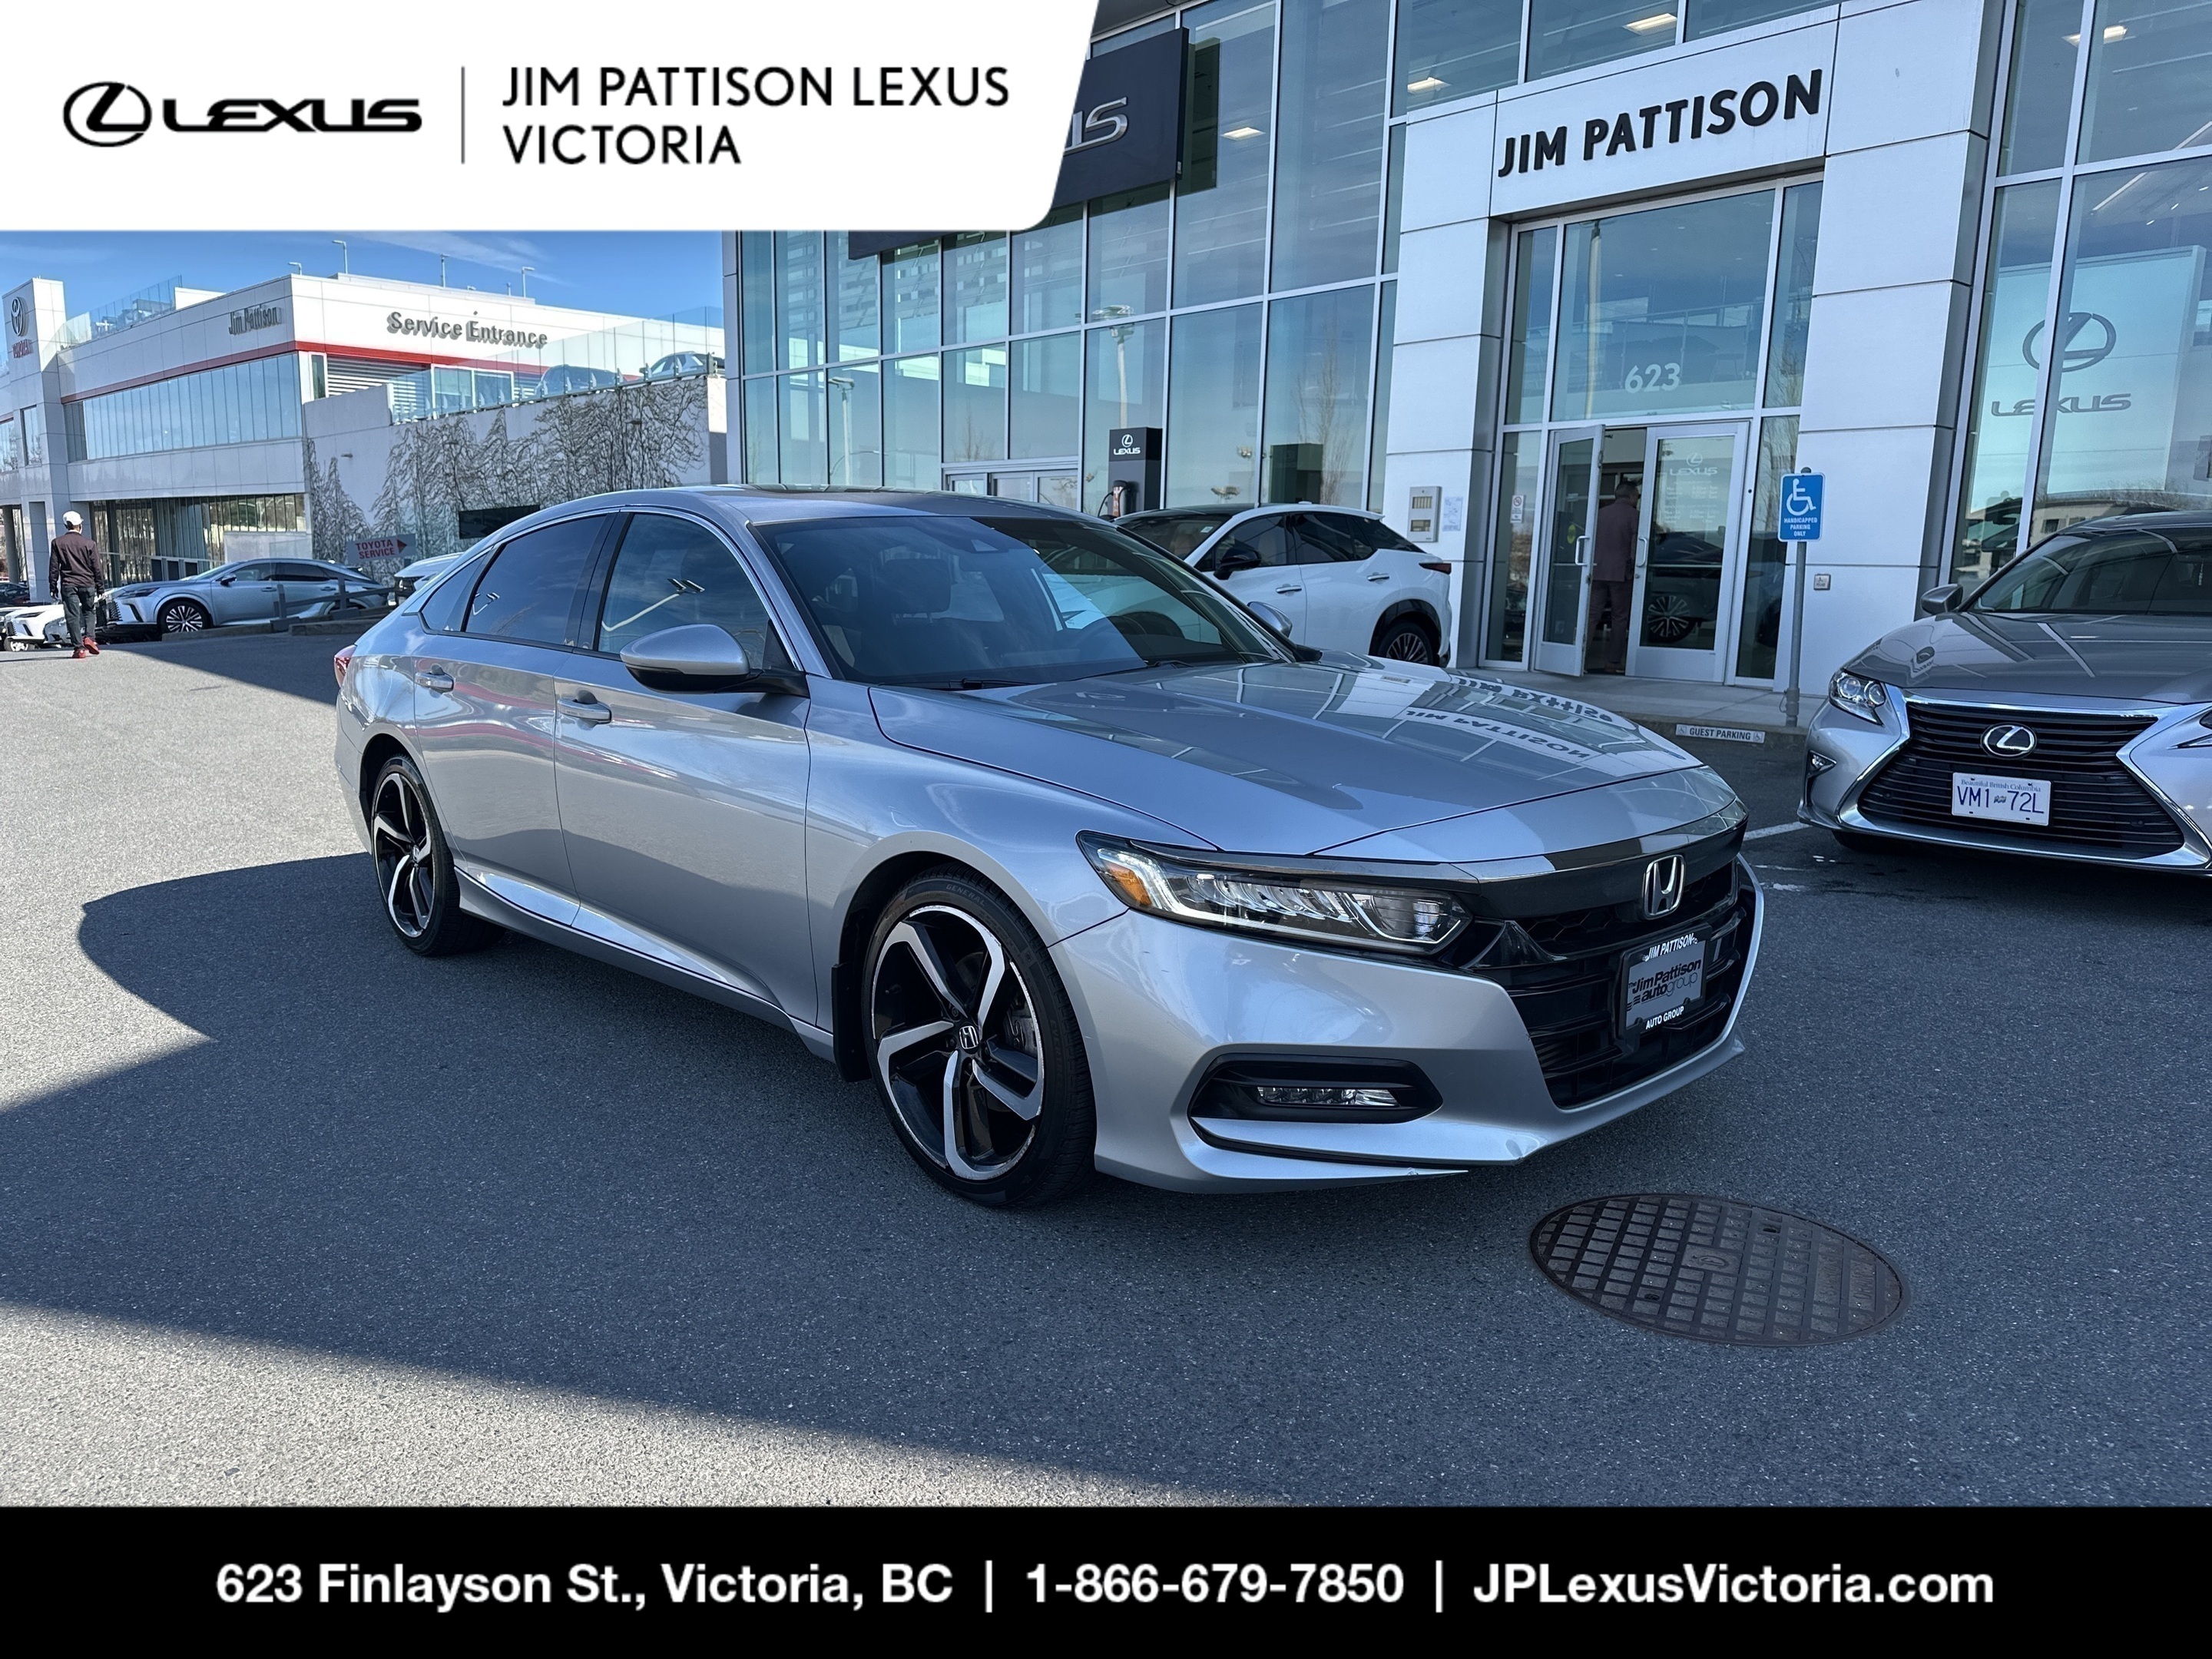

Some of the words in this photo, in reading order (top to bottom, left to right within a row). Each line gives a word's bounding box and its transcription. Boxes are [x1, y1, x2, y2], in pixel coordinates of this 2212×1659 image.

[1498, 125, 1567, 177] JIM
[1583, 68, 1823, 161] PATTISON
[229, 311, 243, 335] Jim
[244, 304, 278, 332] Pattison
[386, 311, 462, 339] Service
[466, 320, 548, 348] Entrance
[1624, 363, 1681, 393] 623
[1114, 447, 1141, 455] LEXUS
[1670, 467, 1718, 475] LEXUS
[356, 539, 393, 551] TOYOTA
[359, 548, 395, 559] SERVICE
[1689, 727, 1714, 737] GUEST
[1716, 730, 1751, 740] PARKING
[1961, 779, 1988, 787] Beautiful
[1989, 781, 2009, 790] British
[2010, 784, 2041, 793] Columbia
[1957, 786, 1989, 808] VM1
[2007, 790, 2045, 813] 72L
[946, 884, 986, 907] GENERAL
[1645, 945, 1660, 962] JIM
[1660, 932, 1694, 955] PATTISON
[1632, 977, 1654, 994] Jim
[1655, 959, 1701, 985] Pattison
[1645, 1015, 1662, 1030] AUTO
[1663, 1006, 1684, 1022] GROUP
